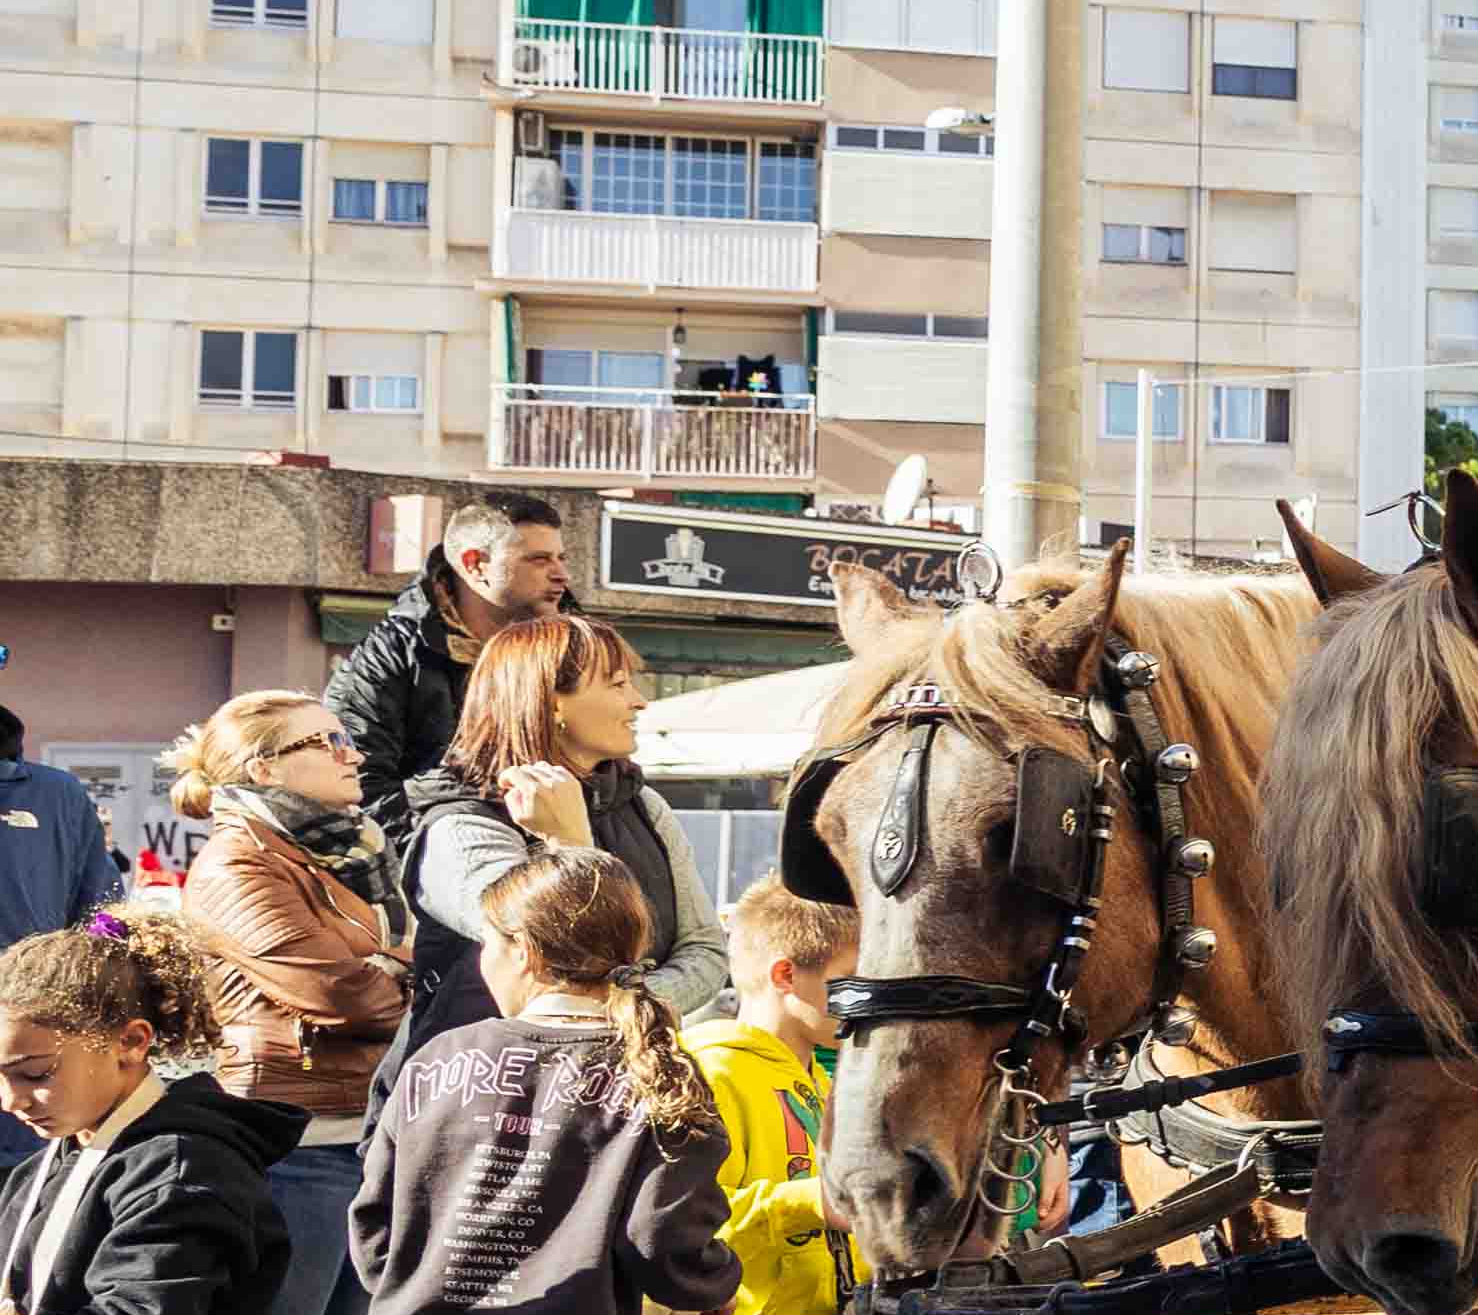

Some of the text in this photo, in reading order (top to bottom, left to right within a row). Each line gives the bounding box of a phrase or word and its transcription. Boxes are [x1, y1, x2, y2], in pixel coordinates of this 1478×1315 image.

[805, 542, 956, 591] BOCATA
[405, 1047, 538, 1123] MORE
[494, 1111, 545, 1136] TOUR
[456, 1212, 536, 1227] ORRISON, CO
[507, 1230, 526, 1239] CO
[519, 1245, 538, 1254] DC
